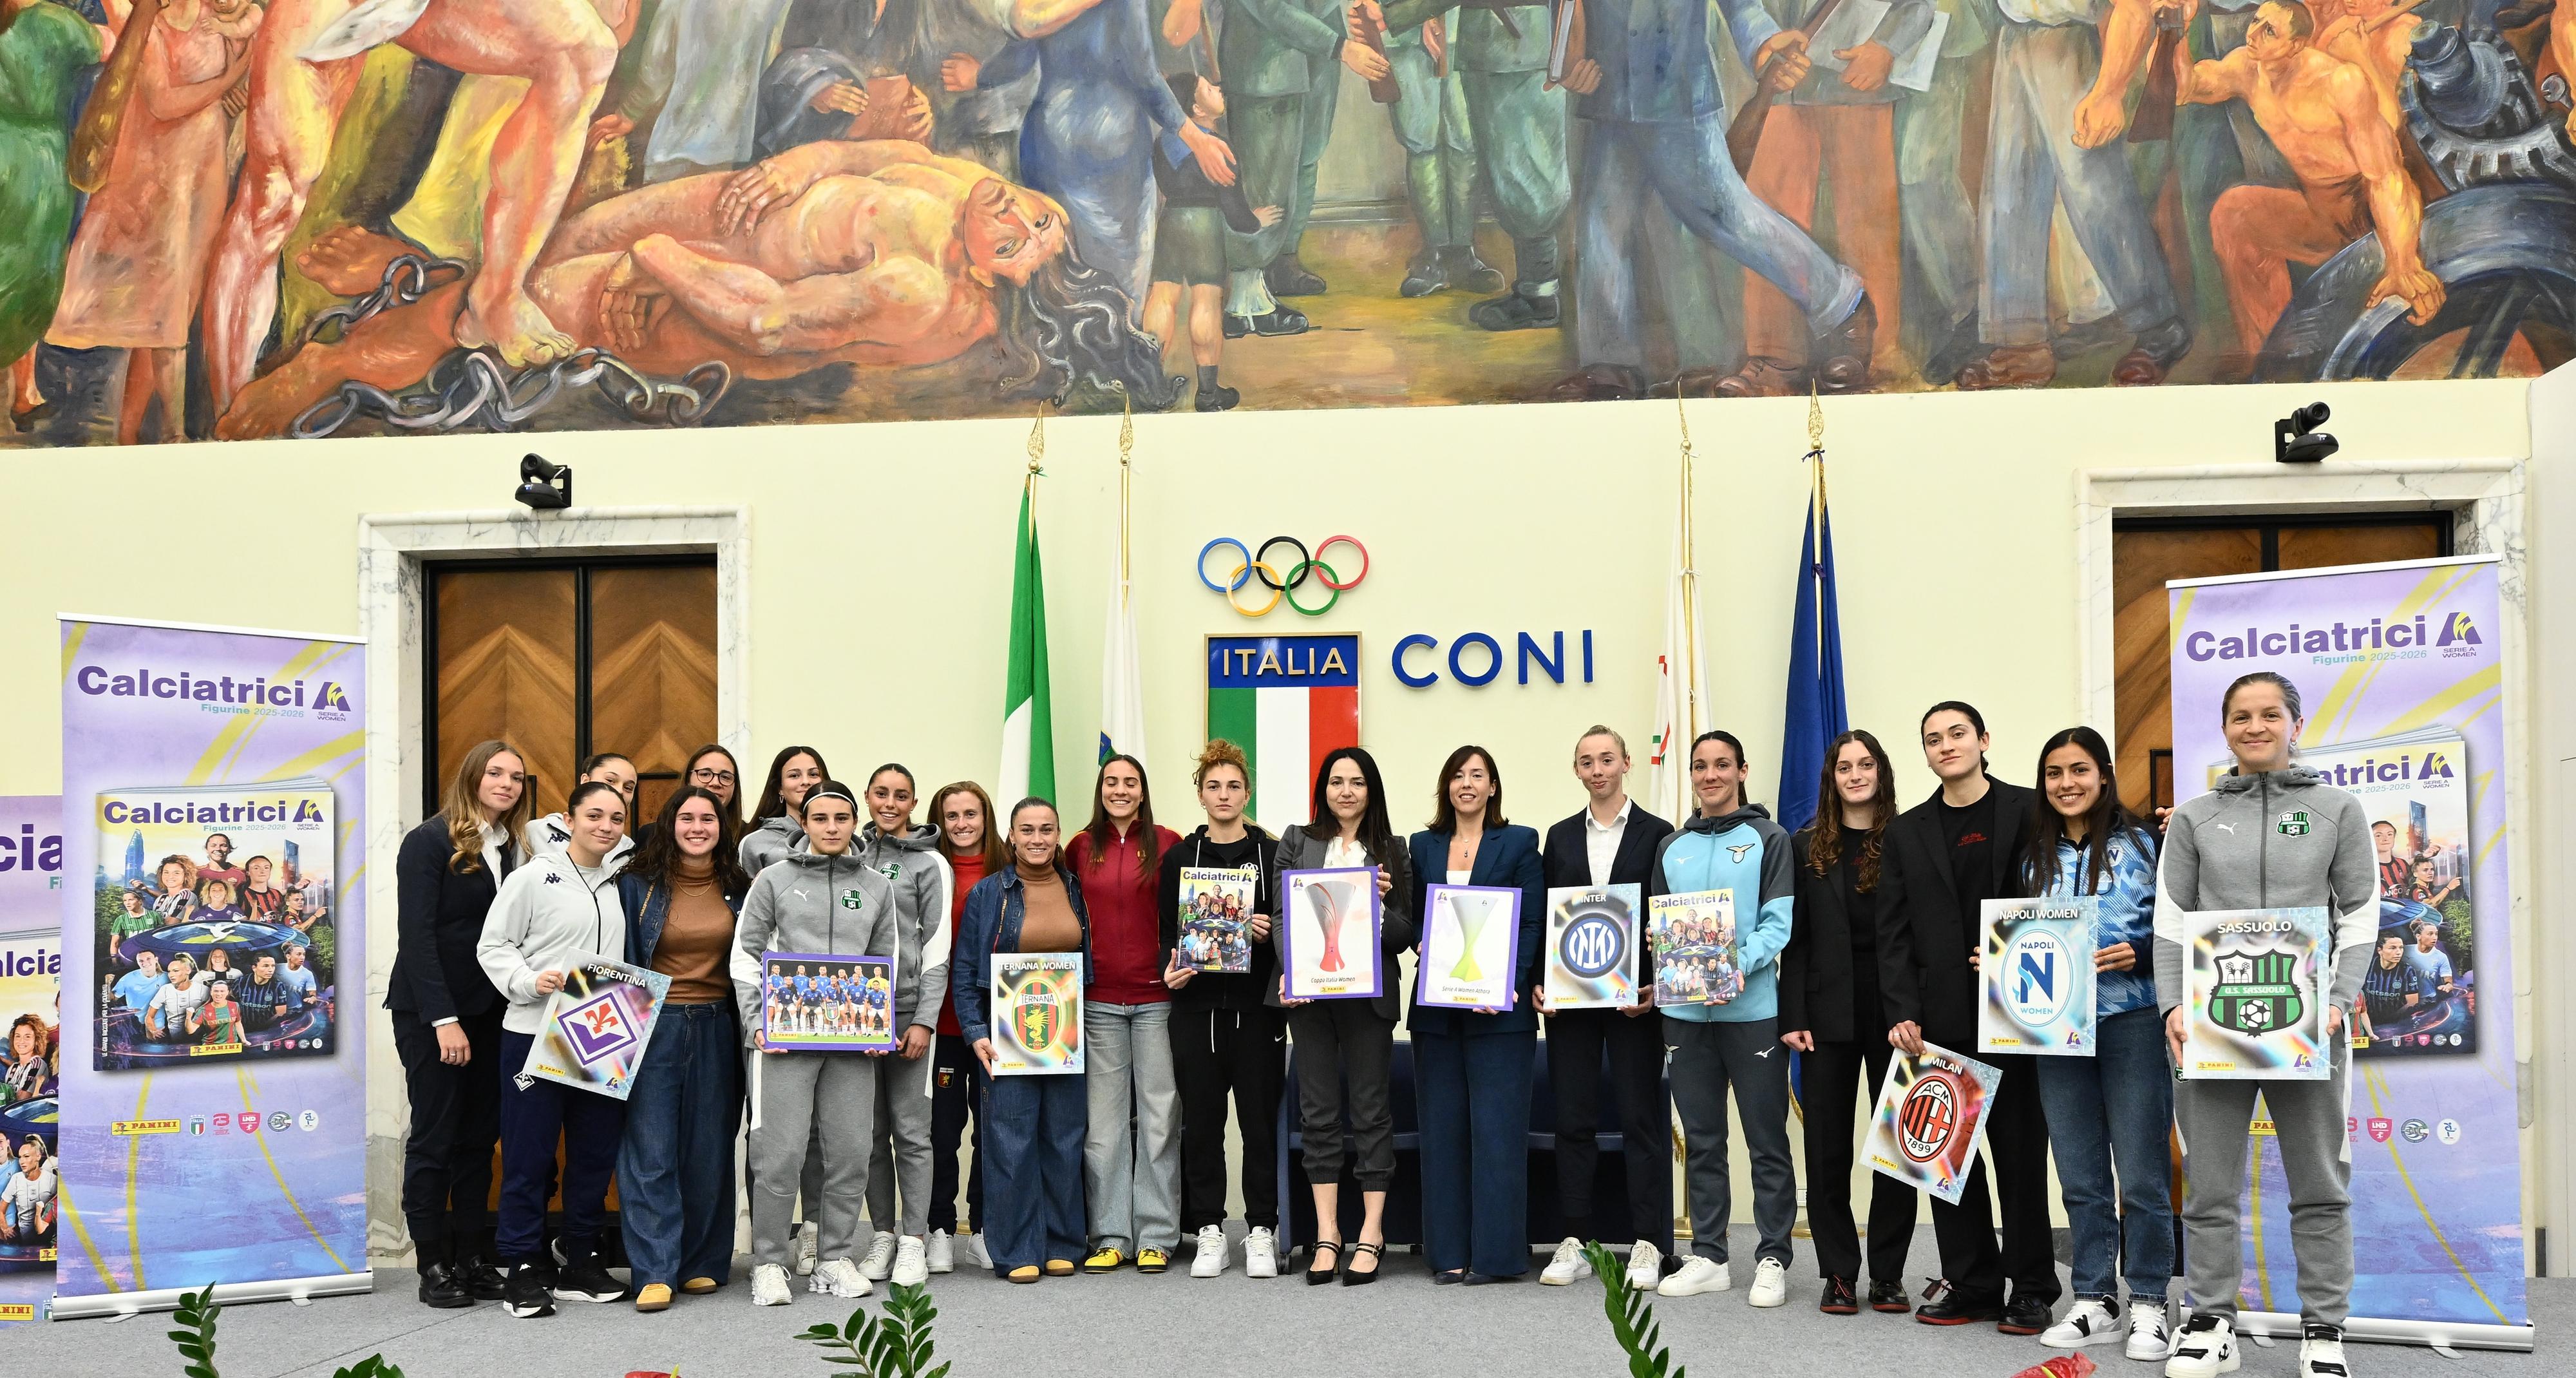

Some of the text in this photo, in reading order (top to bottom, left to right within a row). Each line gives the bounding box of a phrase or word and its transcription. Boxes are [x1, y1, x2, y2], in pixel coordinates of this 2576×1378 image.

[2186, 615, 2427, 662] Calciatrici
[1223, 647, 1348, 676] ITALIA
[1391, 629, 1593, 687] CONI
[2313, 650, 2427, 666] Figurine 2025-2026
[77, 665, 303, 707] Calciatrici
[201, 703, 305, 718] Figurine 2025-2026
[2365, 783, 2410, 793] 2025-2026
[104, 800, 286, 823] Calciatrici
[1183, 871, 1240, 881] Calciatrici
[1581, 894, 1607, 903] INTER
[1651, 894, 1716, 909] Calciatrici
[2000, 908, 2078, 919] NAPOLI WOMEN
[2217, 921, 2292, 933] SASSUOLO
[999, 961, 1076, 971] TERNANA WOMEN
[587, 963, 646, 988] FIORENTINA
[1021, 994, 1055, 1004] TERNANA
[2367, 988, 2400, 997] betsson
[1930, 1056, 1963, 1075] MILAN
[1920, 1084, 1949, 1105] ACM
[131, 1121, 177, 1129] PANINI
[1907, 1137, 1931, 1153] 1899
